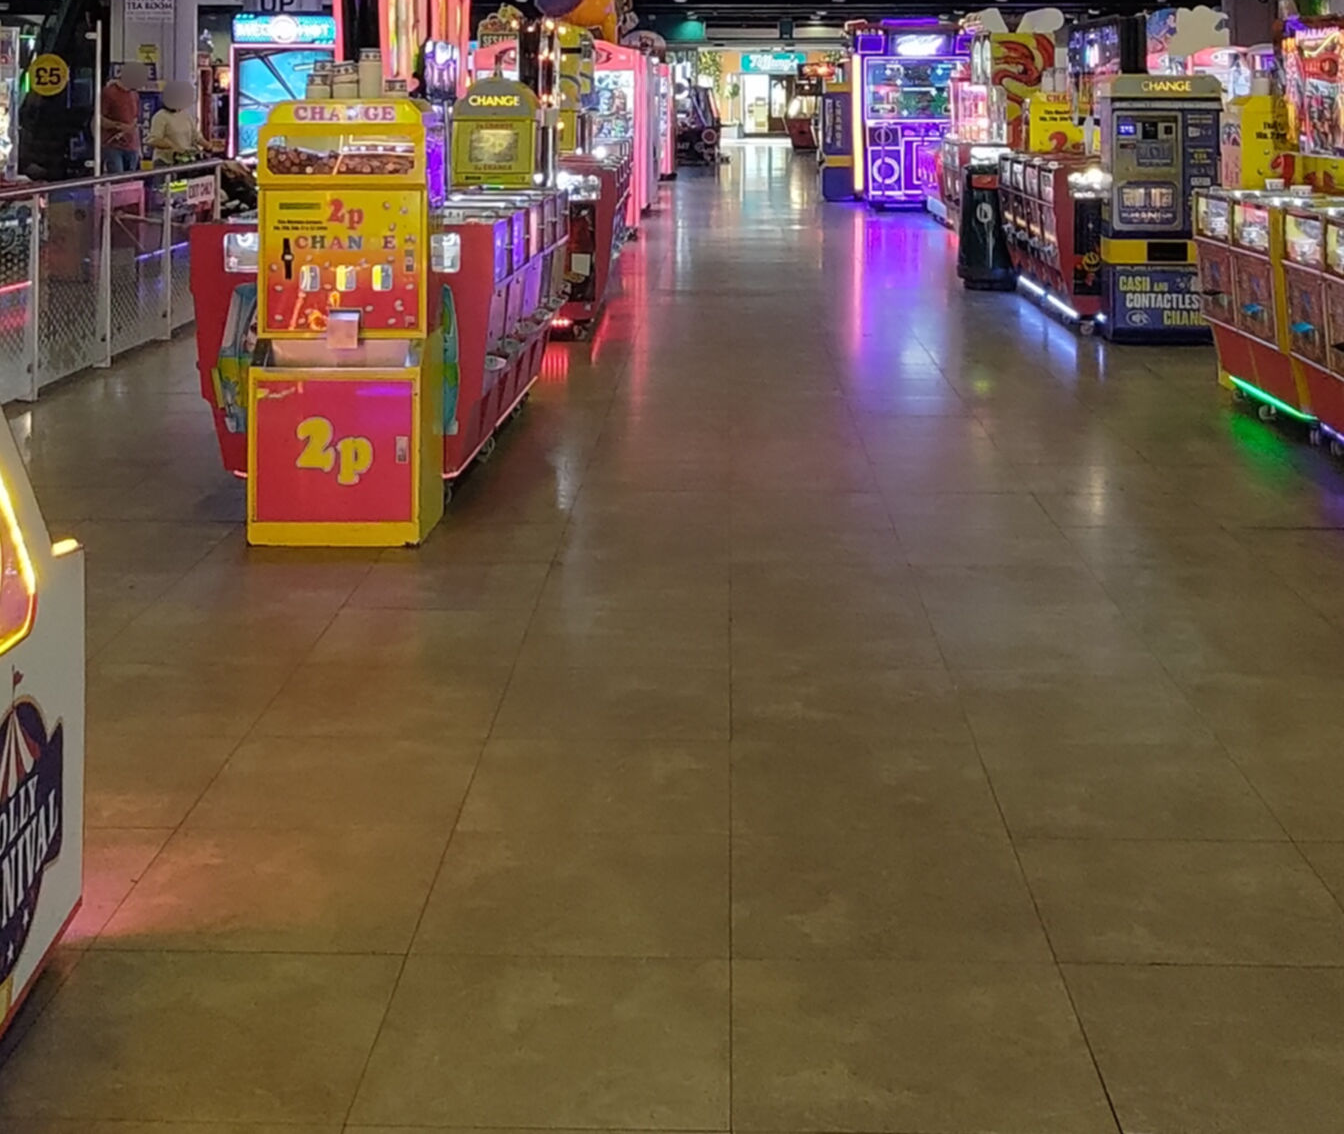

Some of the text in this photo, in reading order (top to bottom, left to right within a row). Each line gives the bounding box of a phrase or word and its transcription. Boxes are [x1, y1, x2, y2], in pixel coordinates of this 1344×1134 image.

[127, 2, 172, 10] TEA ROOM
[35, 67, 61, 86] £5
[1141, 80, 1192, 92] CHANGE
[469, 95, 520, 107] CHANGE
[328, 198, 364, 230] 2p
[1119, 276, 1150, 291] CASH
[296, 416, 374, 485] 2p
